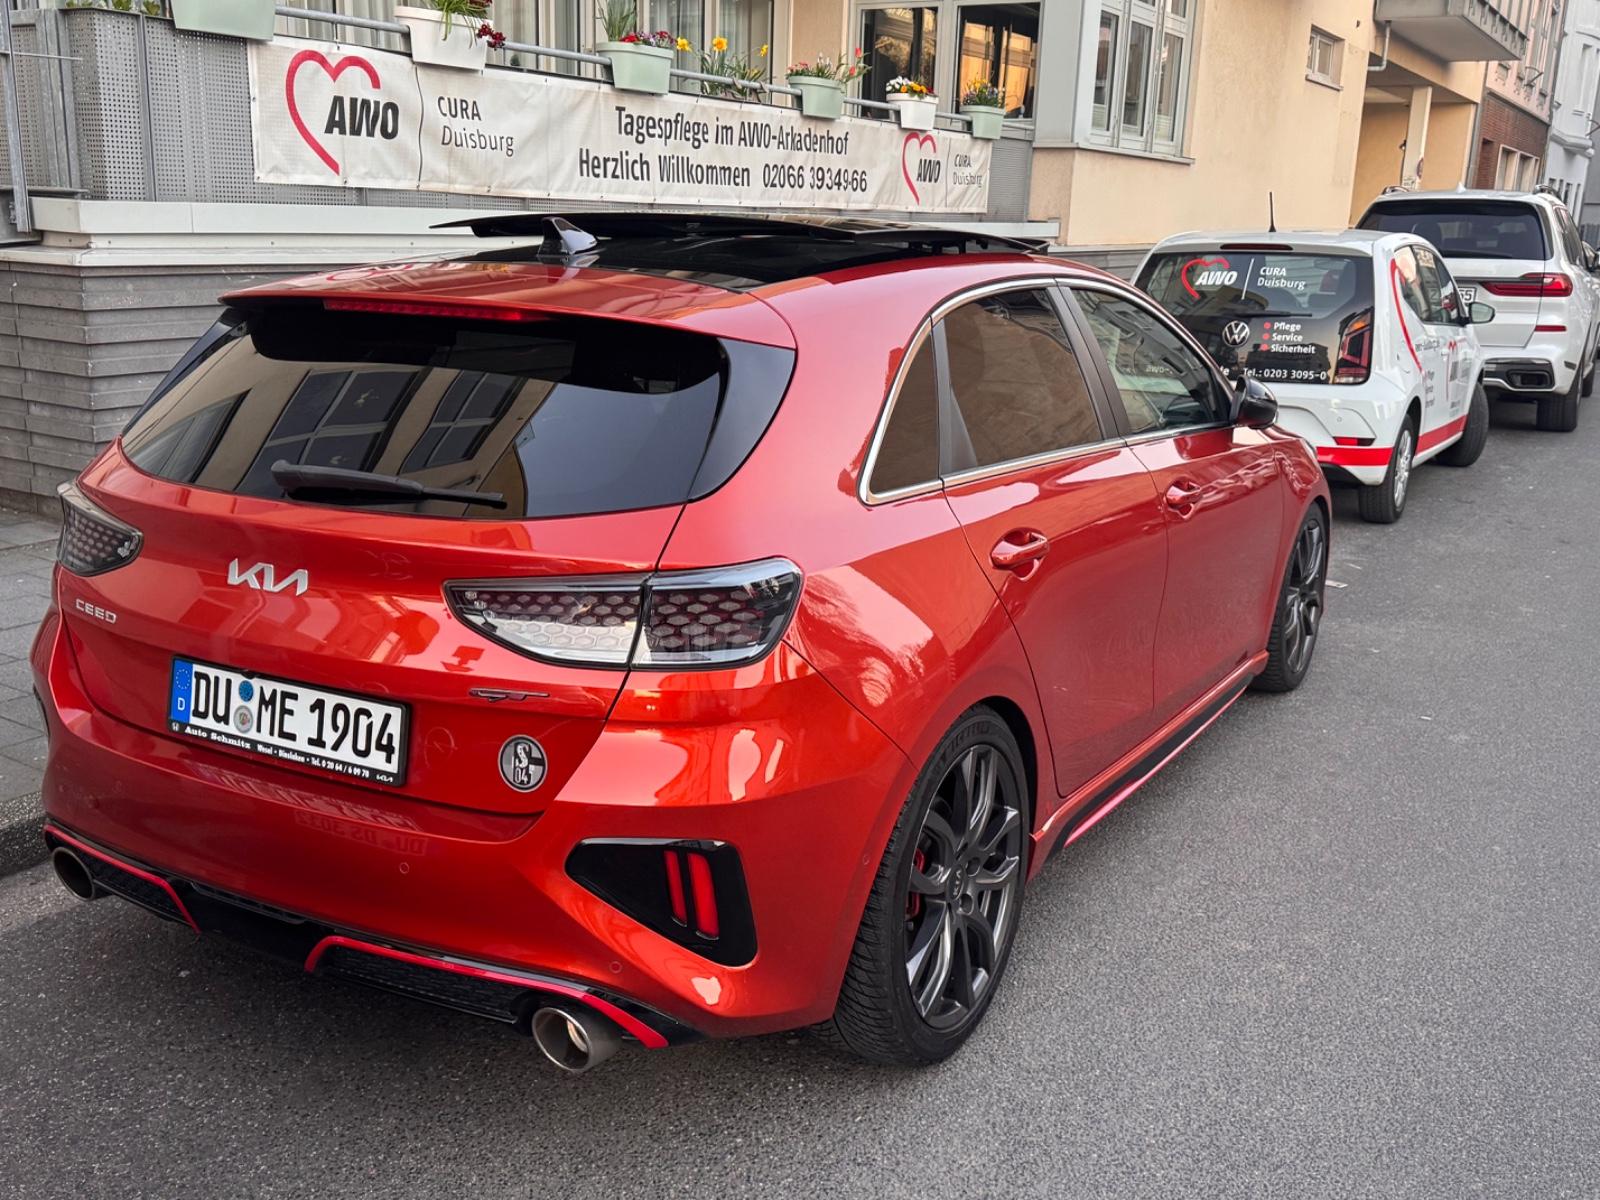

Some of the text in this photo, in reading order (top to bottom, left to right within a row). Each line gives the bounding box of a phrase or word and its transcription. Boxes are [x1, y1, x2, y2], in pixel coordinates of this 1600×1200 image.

[324, 95, 399, 140] AWO
[437, 96, 482, 121] CURA
[615, 105, 849, 155] Tagespflege im AWO-Arkadenhof
[441, 125, 514, 157] Duisburg
[579, 148, 651, 182] Herzlich
[658, 154, 751, 187] Willkommen
[763, 163, 804, 189] 02066
[917, 158, 941, 183] AWO
[954, 153, 972, 168] CURA
[1195, 271, 1238, 286] AWO
[1260, 266, 1287, 276] CURA
[1257, 277, 1306, 290] Duisburg
[1273, 321, 1302, 332] Pflege
[1272, 332, 1303, 342] Service
[1270, 343, 1316, 354] Sicherheit
[1263, 368, 1287, 379] 0203
[1290, 369, 1327, 380] 3095-0
[227, 558, 309, 596] KIA
[75, 598, 117, 624] CEED
[177, 697, 185, 711] D
[192, 670, 395, 764] DU ME 1904
[184, 725, 207, 738] Auto
[210, 732, 251, 749] Schmitz
[514, 767, 529, 784] 04
